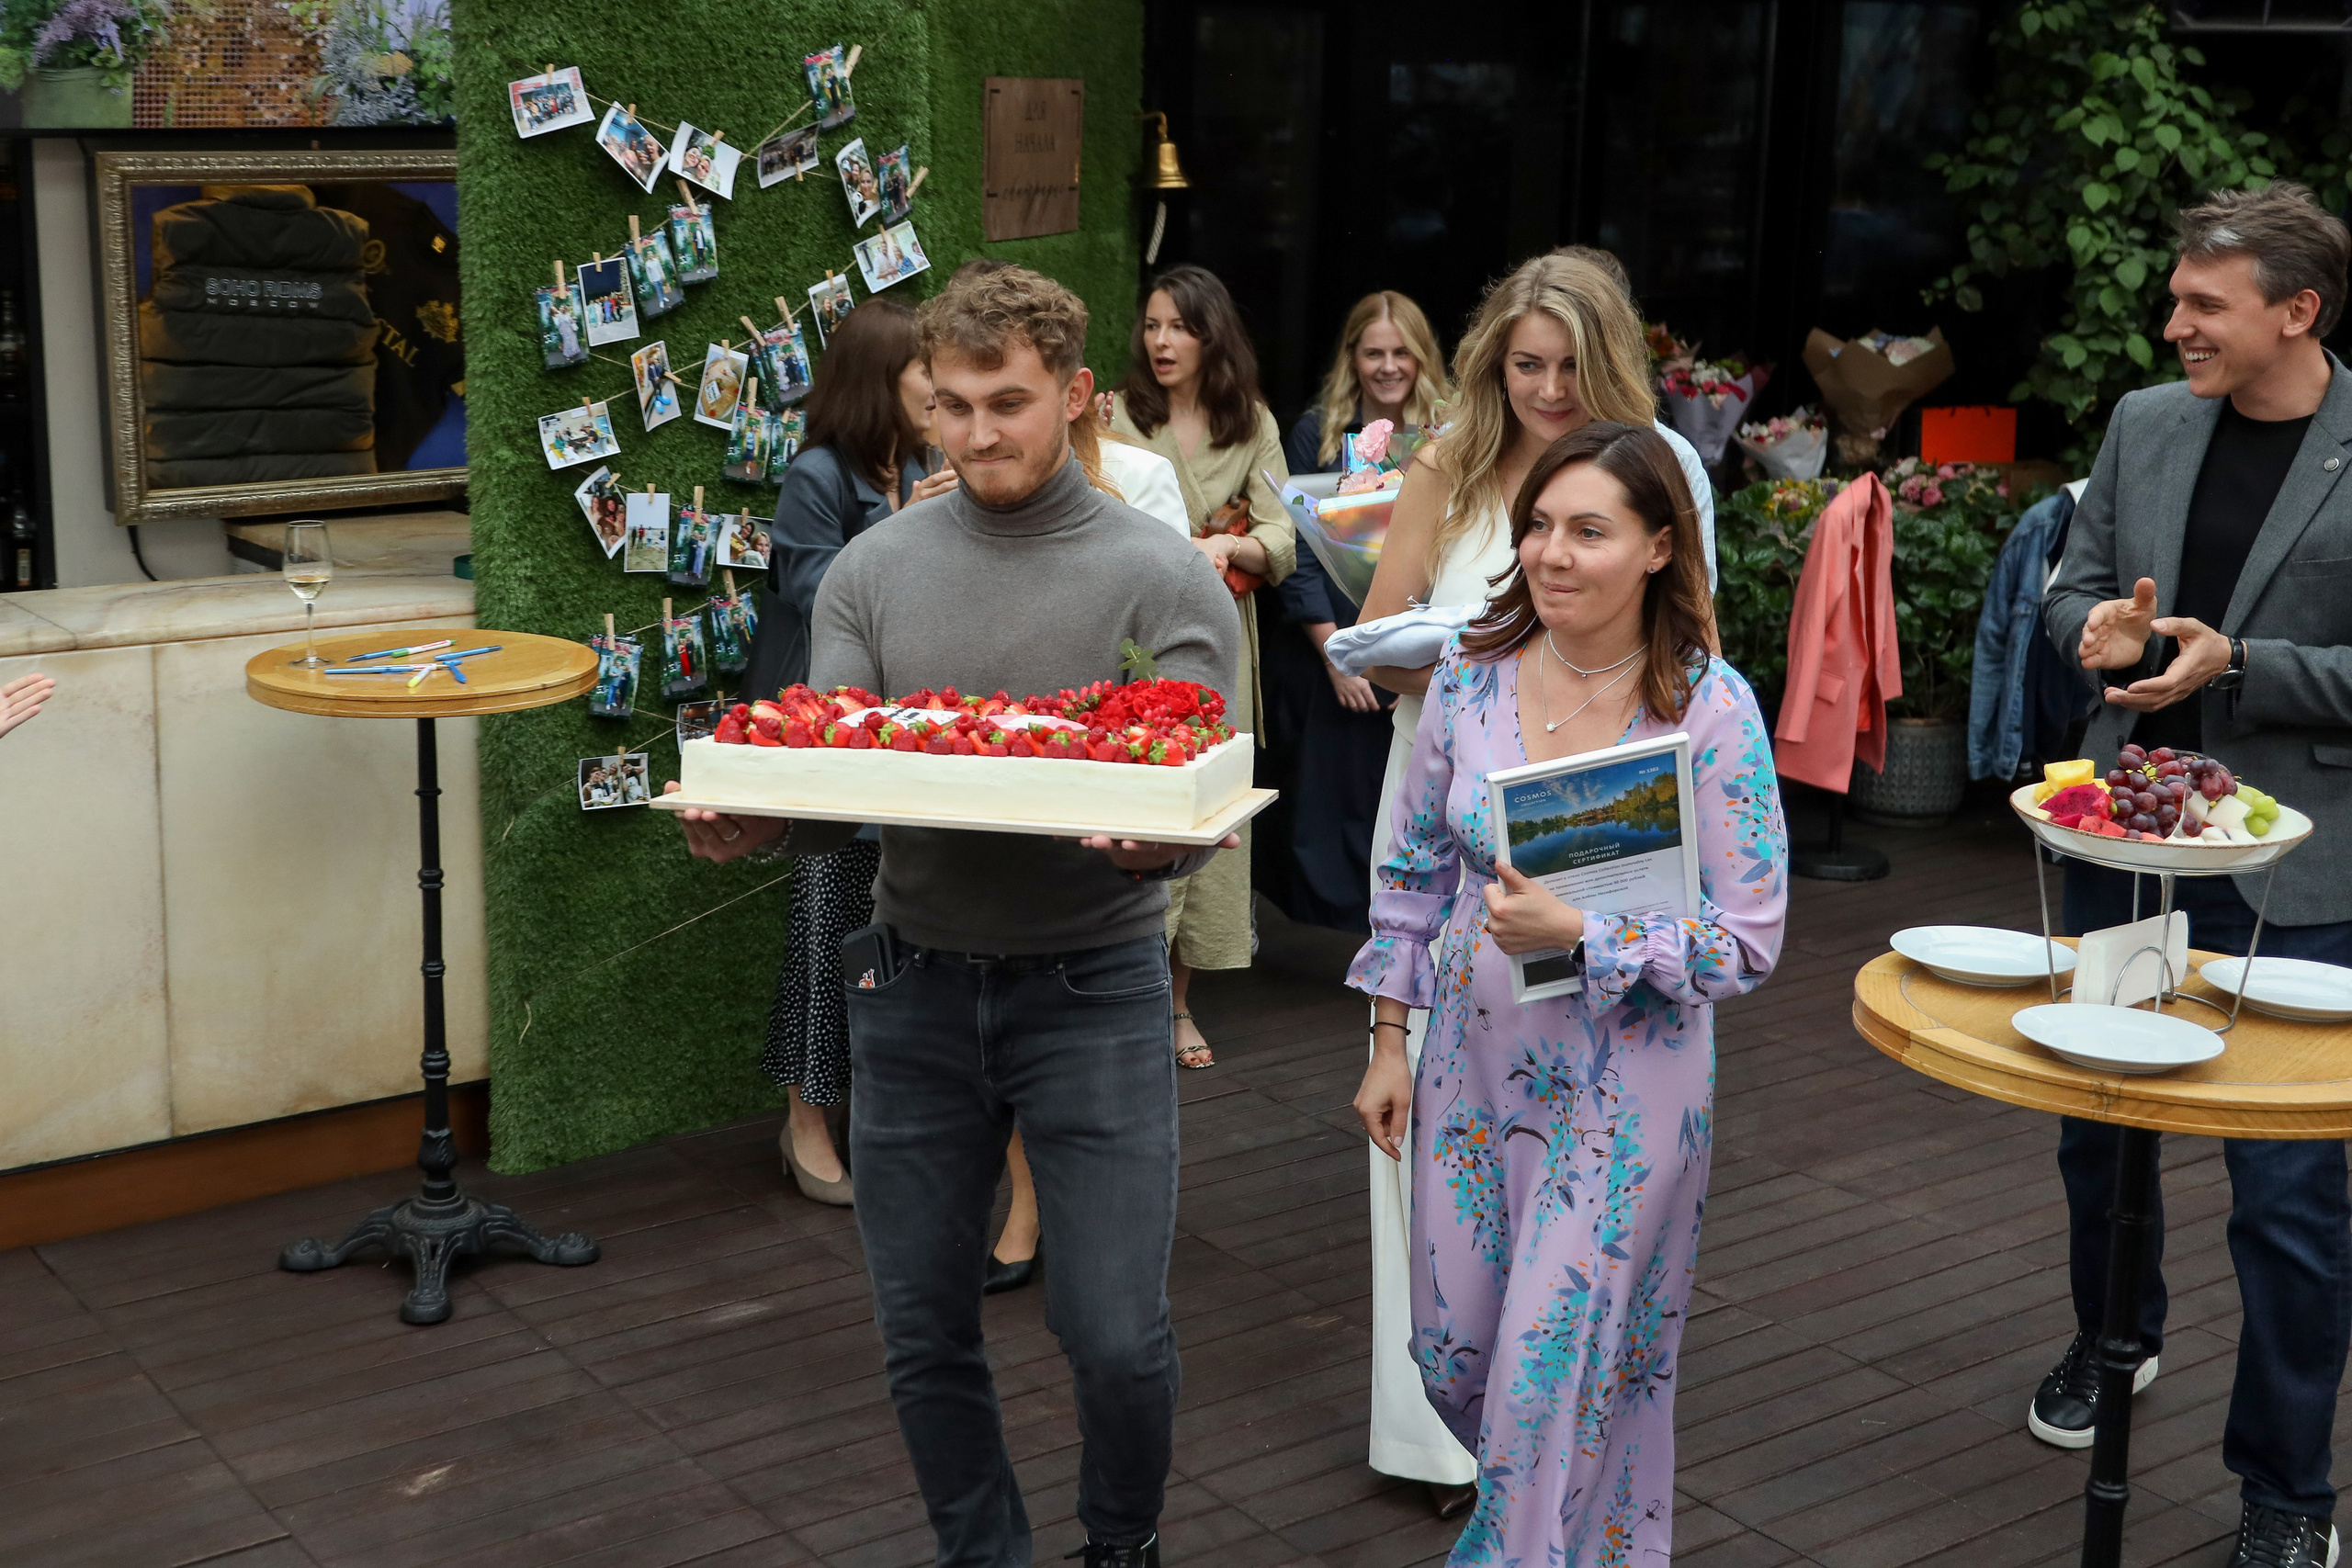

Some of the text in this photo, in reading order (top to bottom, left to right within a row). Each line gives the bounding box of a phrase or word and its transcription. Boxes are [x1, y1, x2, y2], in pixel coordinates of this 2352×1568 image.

[205, 277, 262, 297] SOHO
[206, 297, 320, 309] MOSCOW
[1514, 790, 1553, 803] COSMOS
[1568, 842, 1621, 859] ПОДАРОЧНЫЙ
[1572, 850, 1620, 864] СЕРТИФИКАТ
